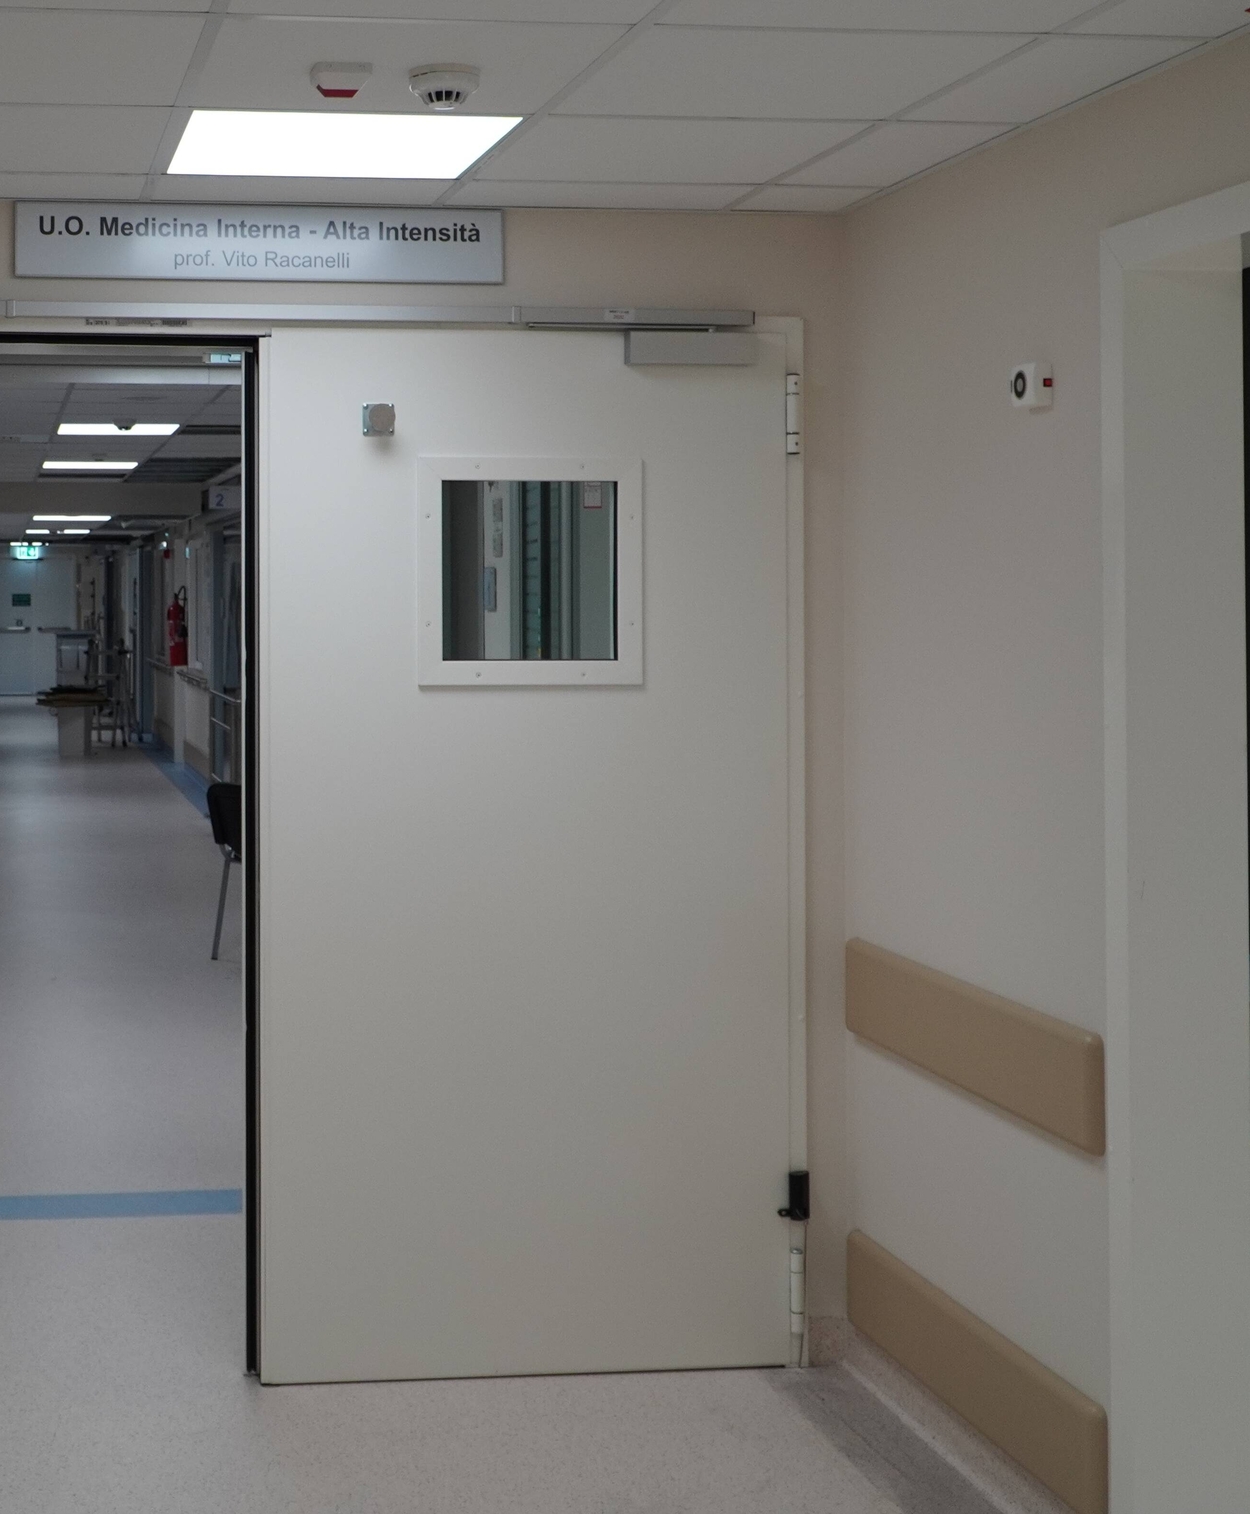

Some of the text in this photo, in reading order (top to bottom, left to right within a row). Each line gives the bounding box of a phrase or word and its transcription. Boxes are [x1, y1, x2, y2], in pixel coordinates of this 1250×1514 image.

[38, 215, 91, 236] U.O.
[99, 217, 208, 238] Medicina
[217, 218, 301, 239] Interna
[323, 220, 371, 241] Alta
[378, 221, 481, 243] Intensità
[174, 250, 350, 270] prof. Vito Racanelli
[215, 493, 224, 507] 2
